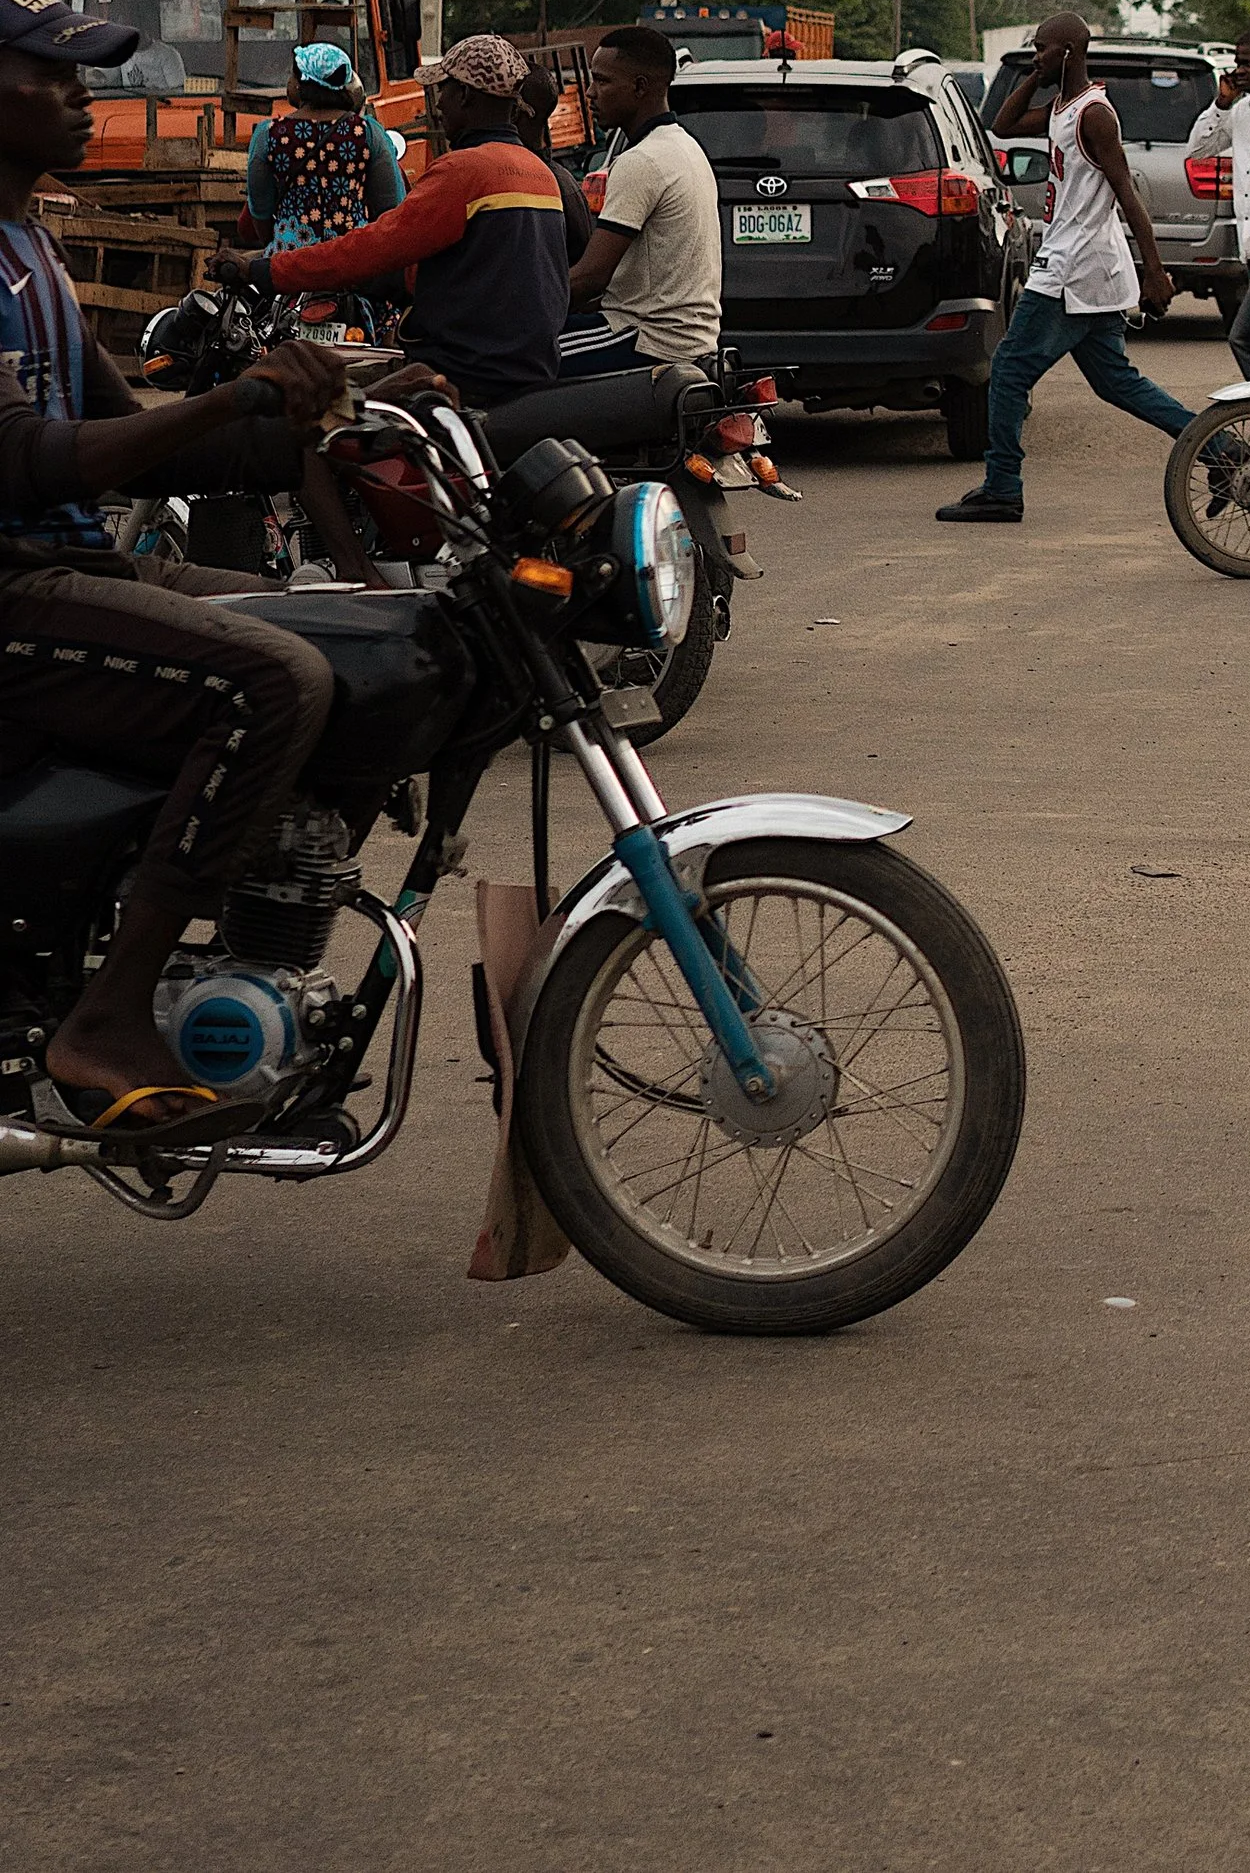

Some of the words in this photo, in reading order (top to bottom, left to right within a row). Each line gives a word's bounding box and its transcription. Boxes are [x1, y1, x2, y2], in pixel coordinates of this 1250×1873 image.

[739, 214, 802, 233] BDG-06AZ
[53, 648, 88, 663] NIKE
[103, 655, 140, 674] NIKE
[153, 666, 192, 683] NIKE
[203, 763, 228, 803] NIKE
[178, 815, 201, 855] NIKE
[193, 1034, 249, 1044] BAJAJ
